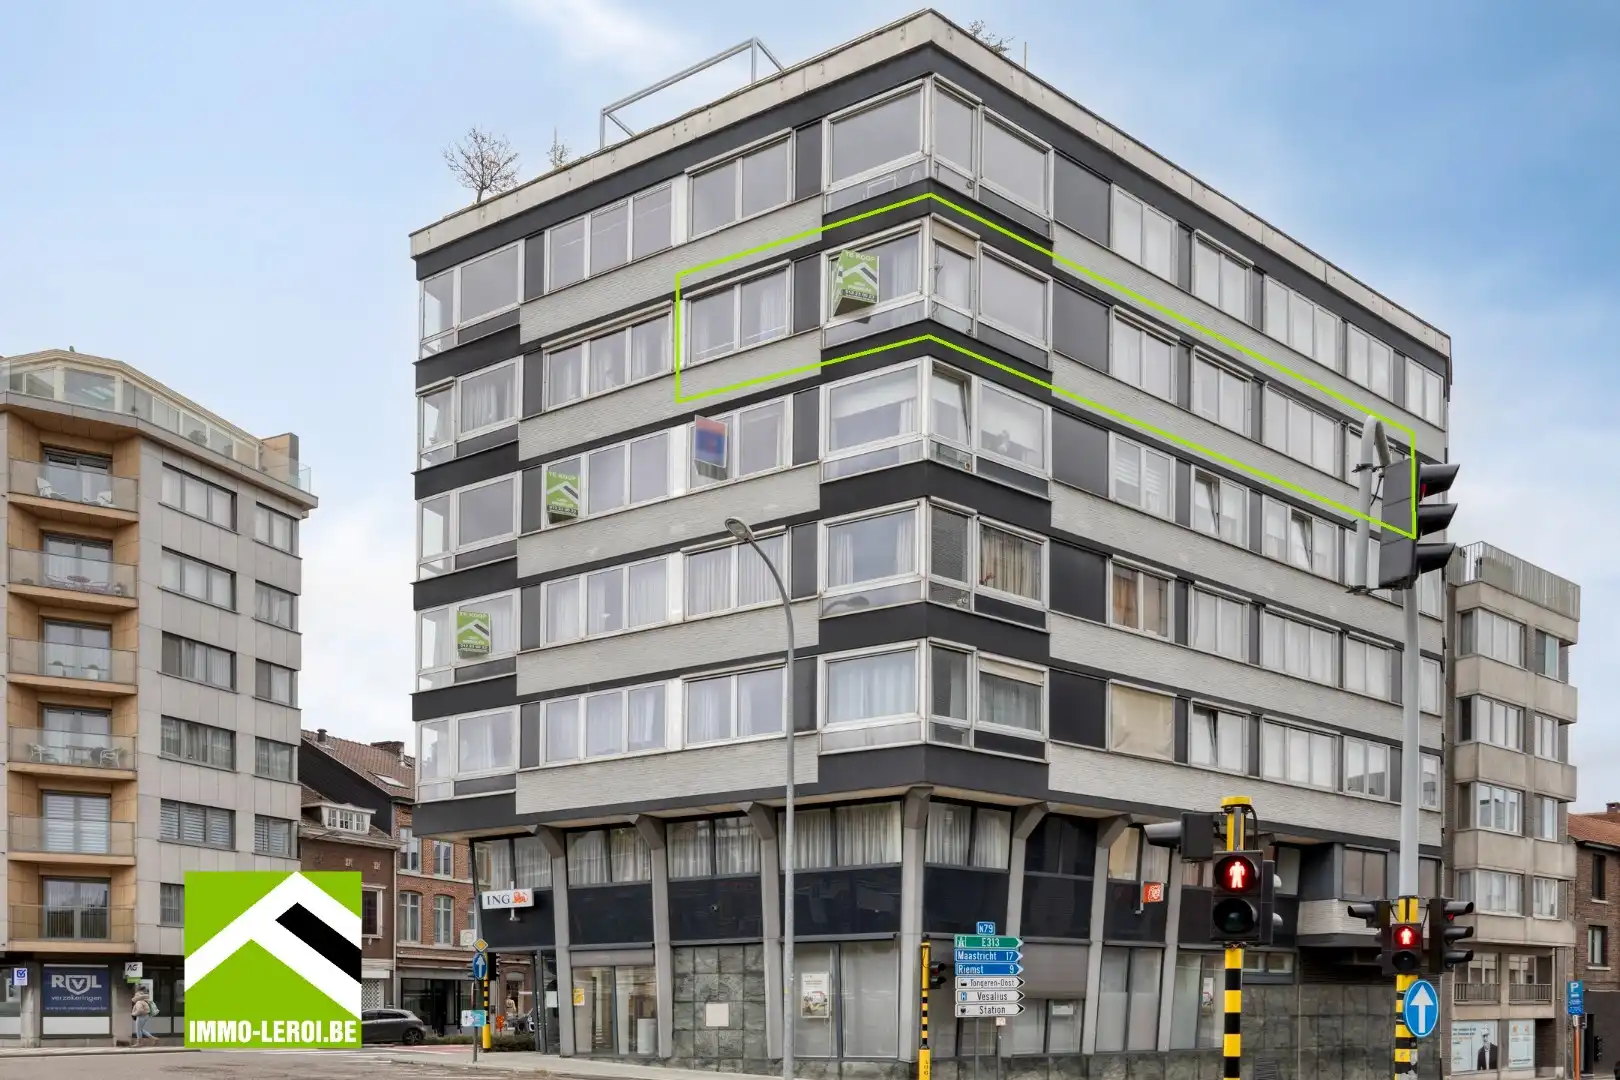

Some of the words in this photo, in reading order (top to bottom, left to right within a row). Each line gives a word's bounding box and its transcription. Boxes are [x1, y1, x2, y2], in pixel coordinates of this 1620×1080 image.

[487, 895, 510, 905] ING
[979, 924, 994, 933] N79
[981, 937, 1000, 947] E313
[957, 951, 997, 960] Maastricht
[1006, 952, 1014, 960] 17
[958, 965, 984, 974] Riemst
[1009, 965, 1014, 974] 9
[970, 979, 1015, 988] Tongeren-Oost
[1570, 983, 1579, 993] P
[51, 995, 102, 1003] verzekeringen
[977, 992, 1008, 1001] Vesalius
[979, 1005, 1006, 1014] Station
